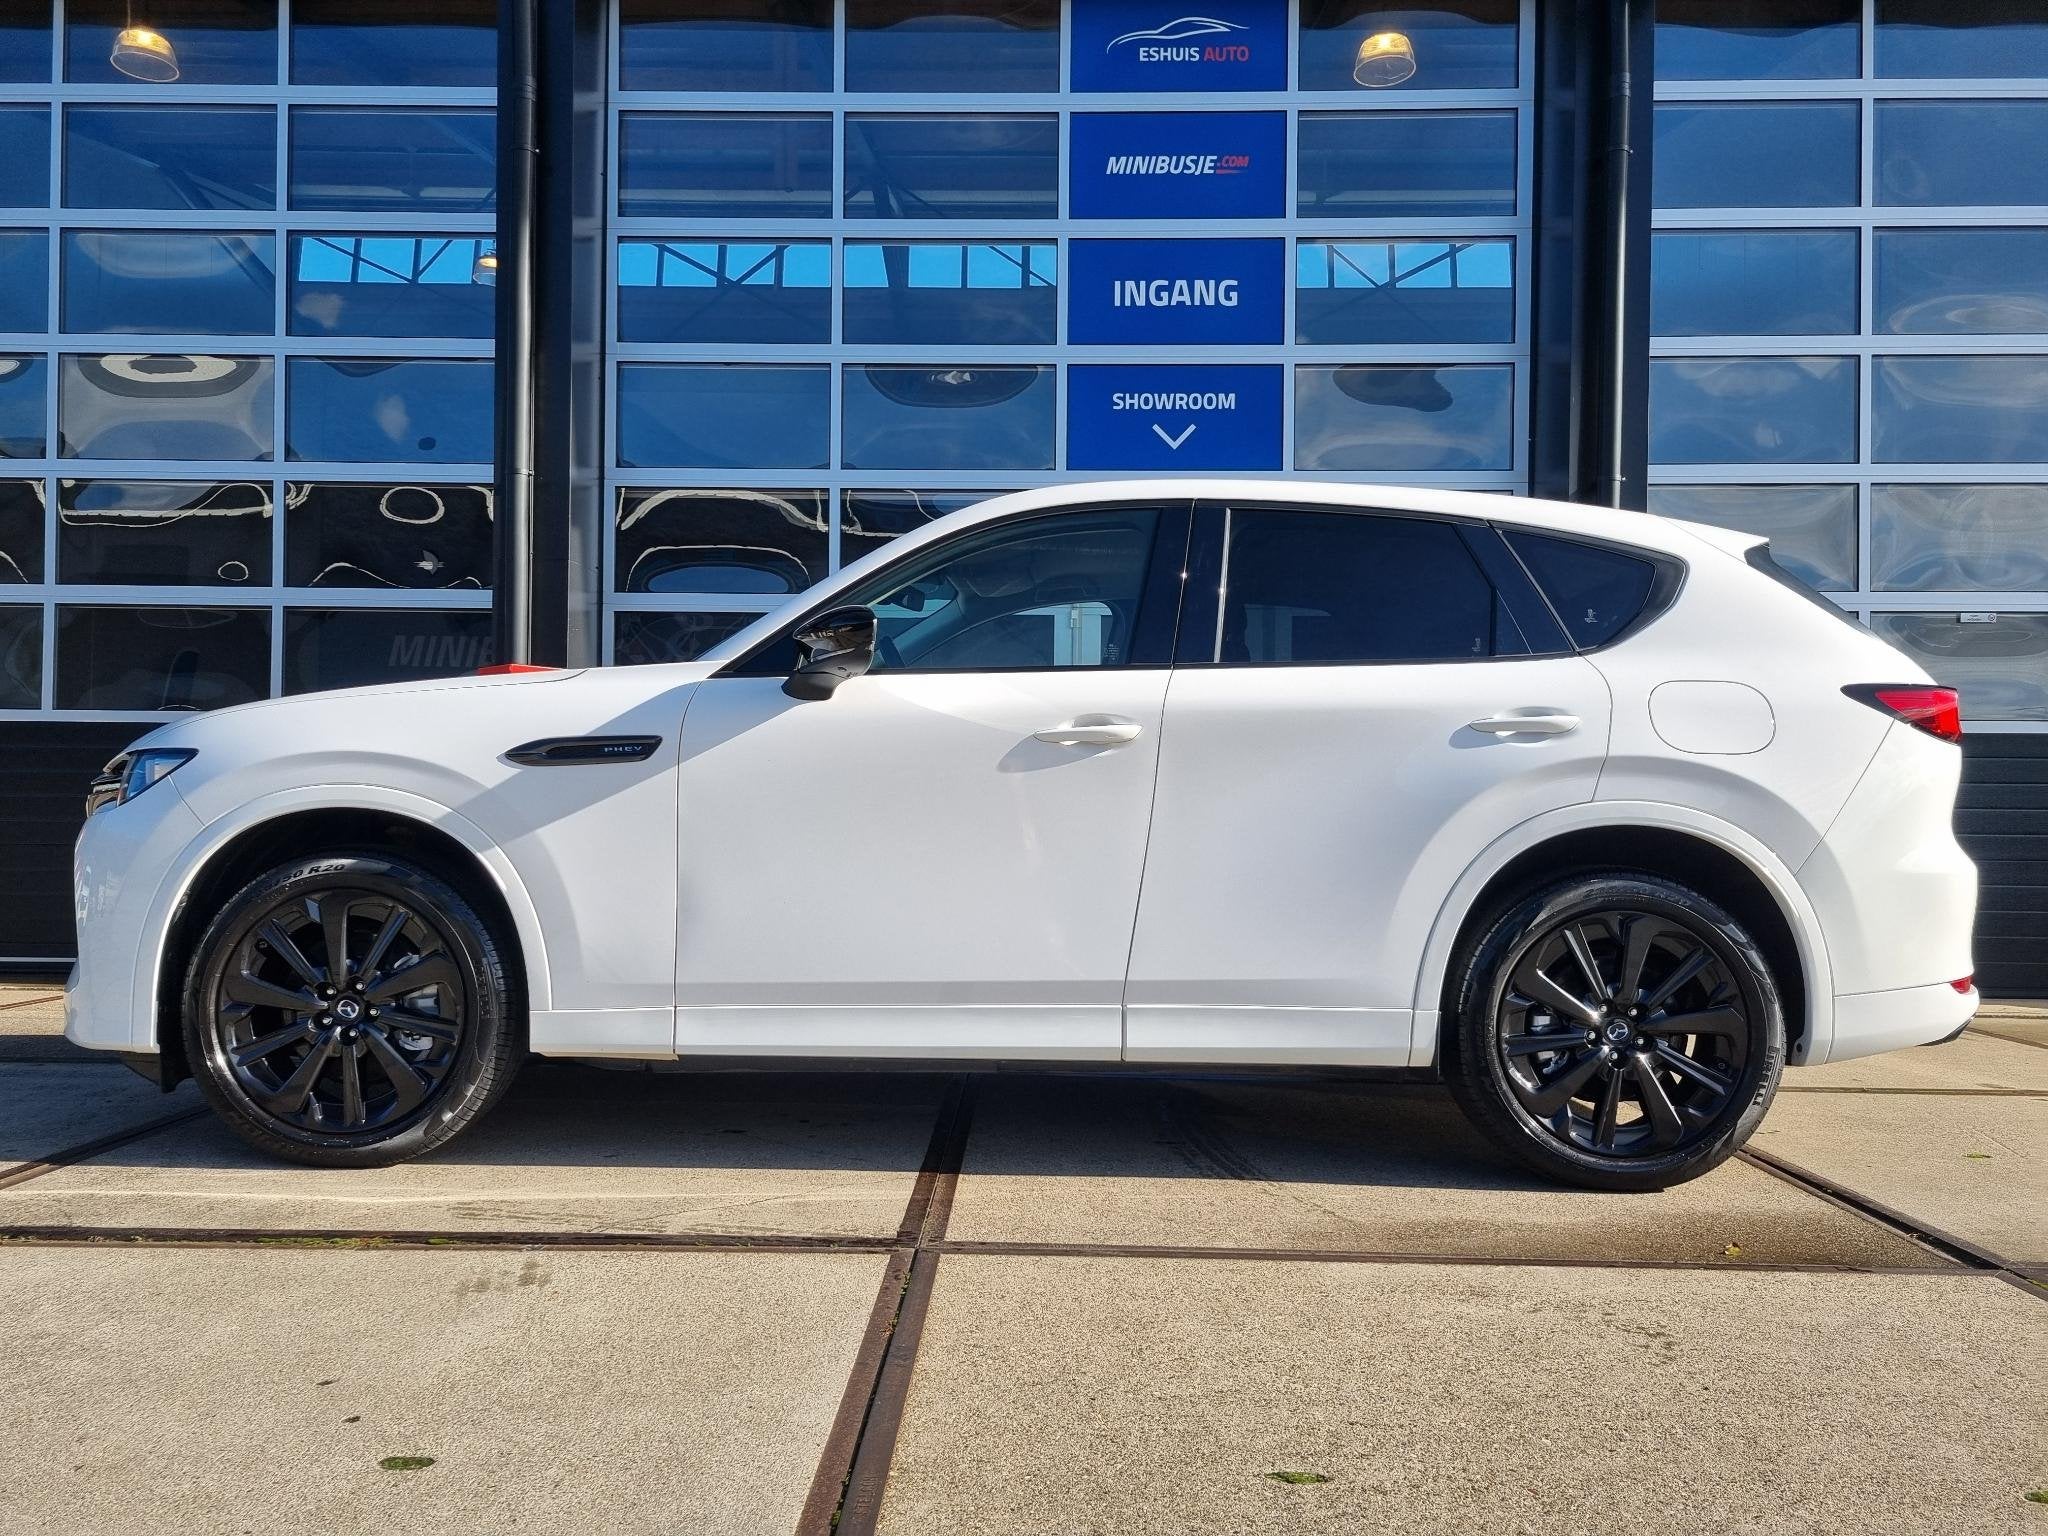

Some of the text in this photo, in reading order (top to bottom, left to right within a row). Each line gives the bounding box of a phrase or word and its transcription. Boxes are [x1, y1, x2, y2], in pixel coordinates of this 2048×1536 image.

[1139, 47, 1249, 61] ESHUIS AUTO
[1114, 279, 1238, 306] INGANG
[1112, 393, 1236, 409] SHOWROOM
